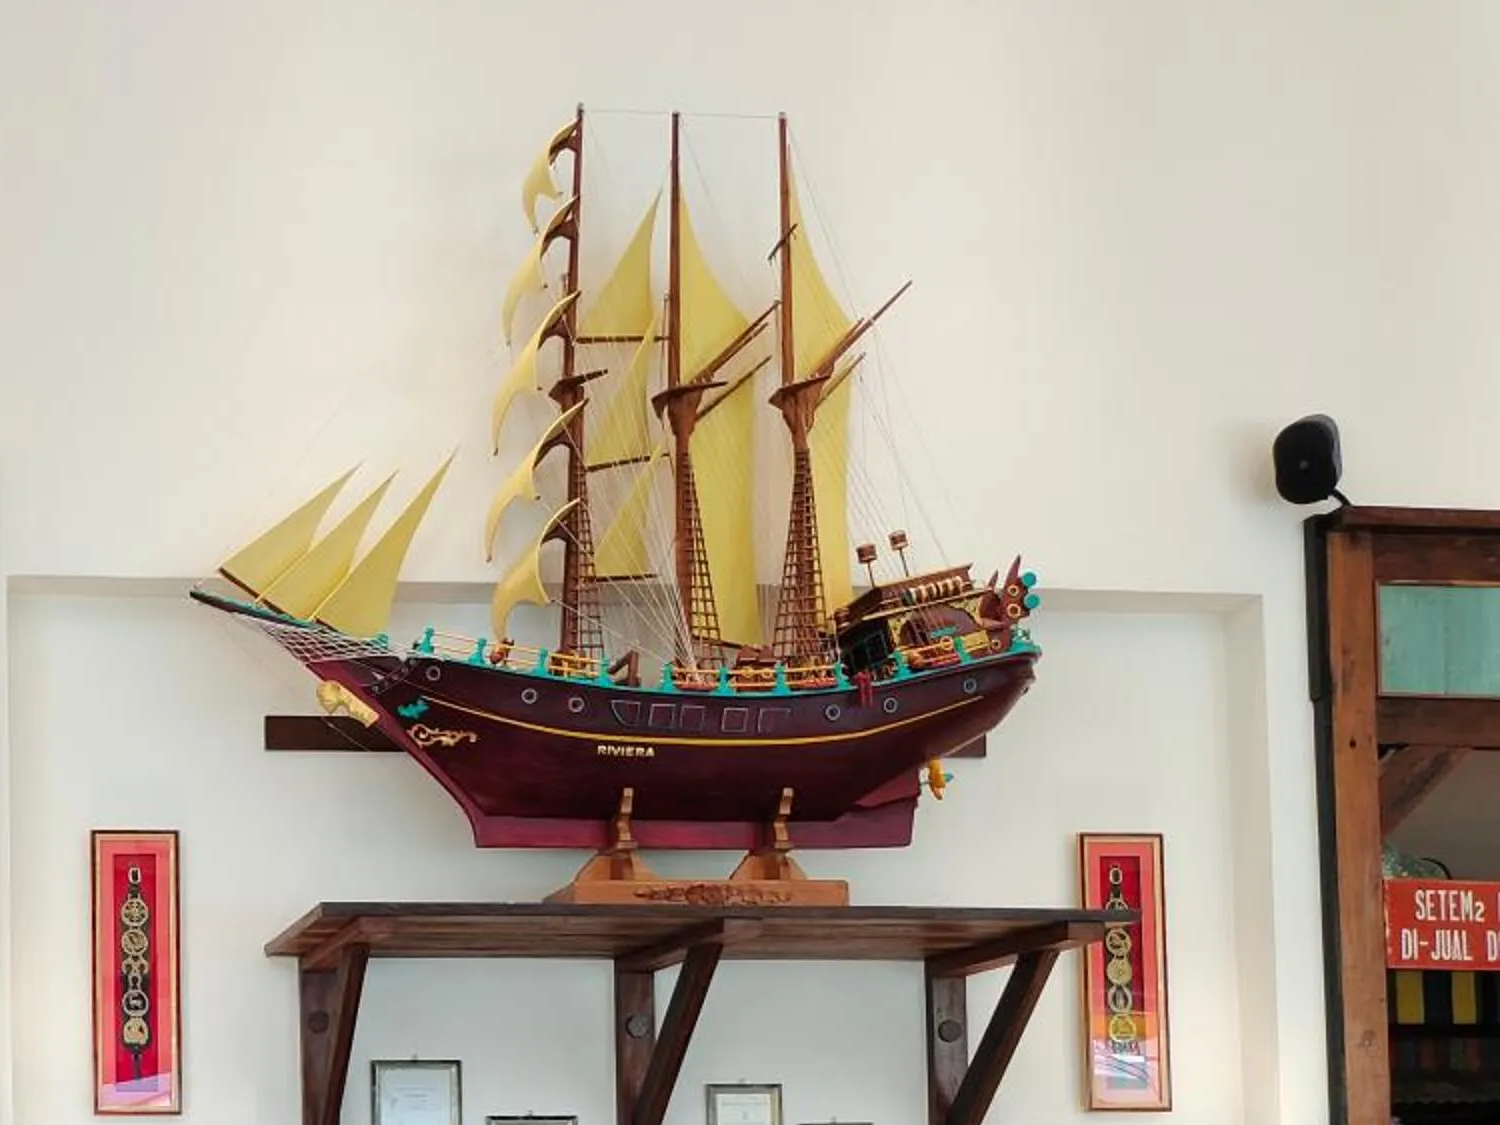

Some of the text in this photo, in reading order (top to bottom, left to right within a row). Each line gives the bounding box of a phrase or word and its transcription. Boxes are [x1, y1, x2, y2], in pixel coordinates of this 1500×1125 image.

[597, 745, 656, 757] RIVIERA
[1414, 888, 1485, 922] SETEM2
[1400, 927, 1474, 961] DI-JUAL
